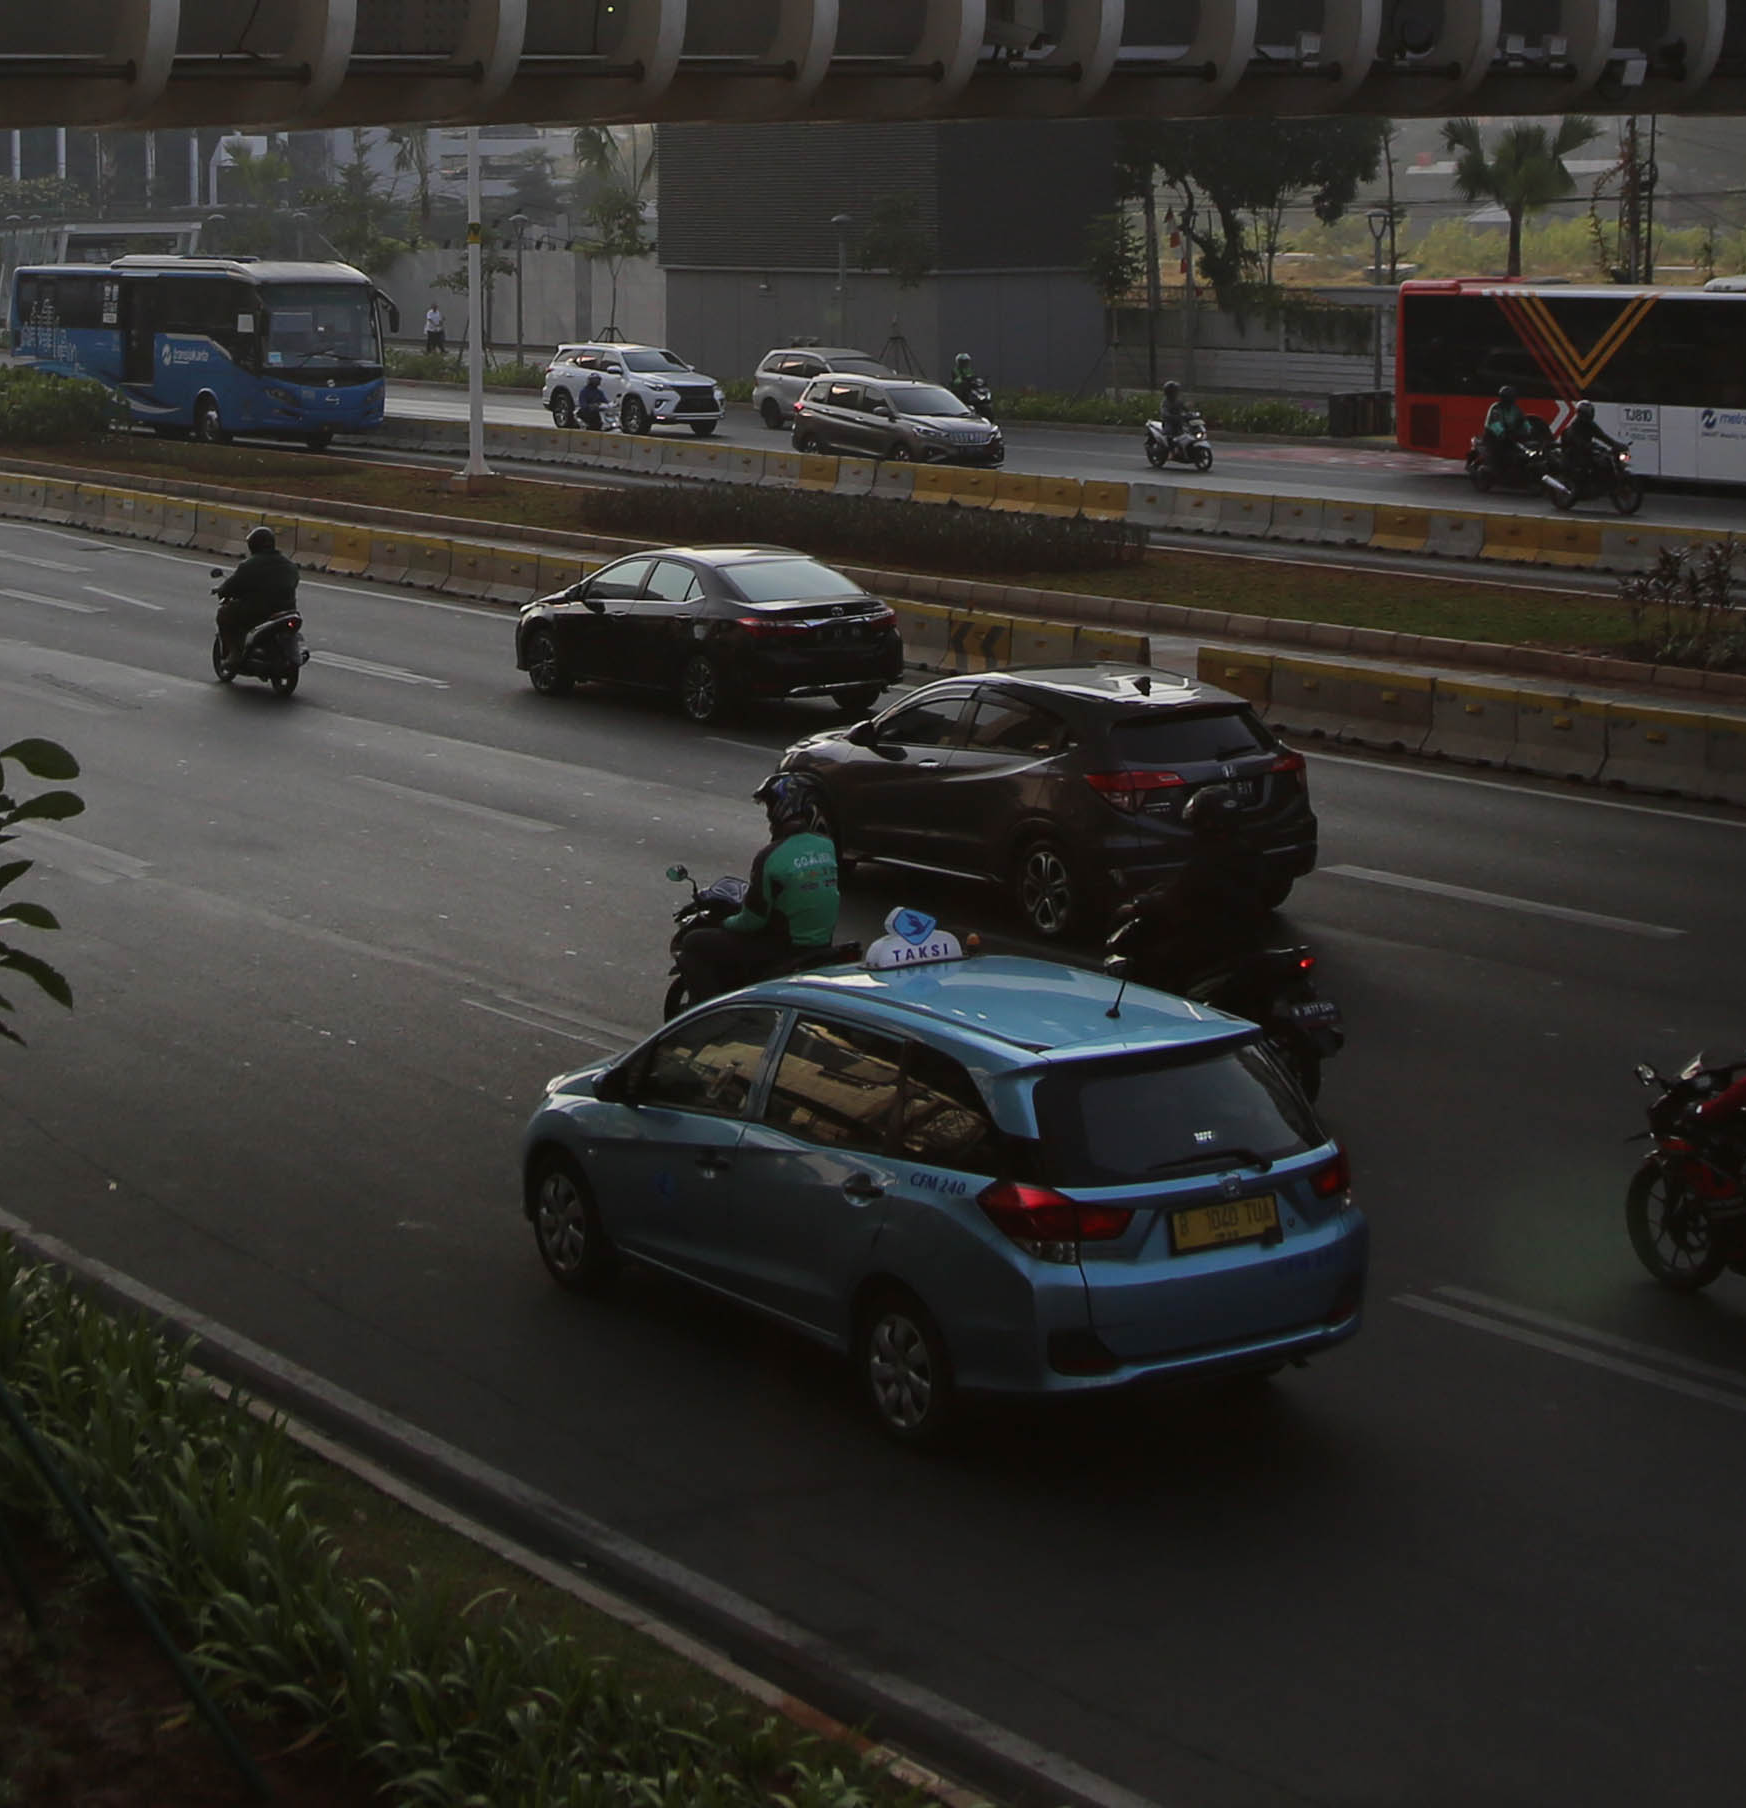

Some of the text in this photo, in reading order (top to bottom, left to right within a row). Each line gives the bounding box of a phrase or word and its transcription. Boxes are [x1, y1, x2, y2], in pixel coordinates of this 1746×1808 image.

[892, 943, 949, 962] TAKSI
[911, 1172, 967, 1195] CFM 240
